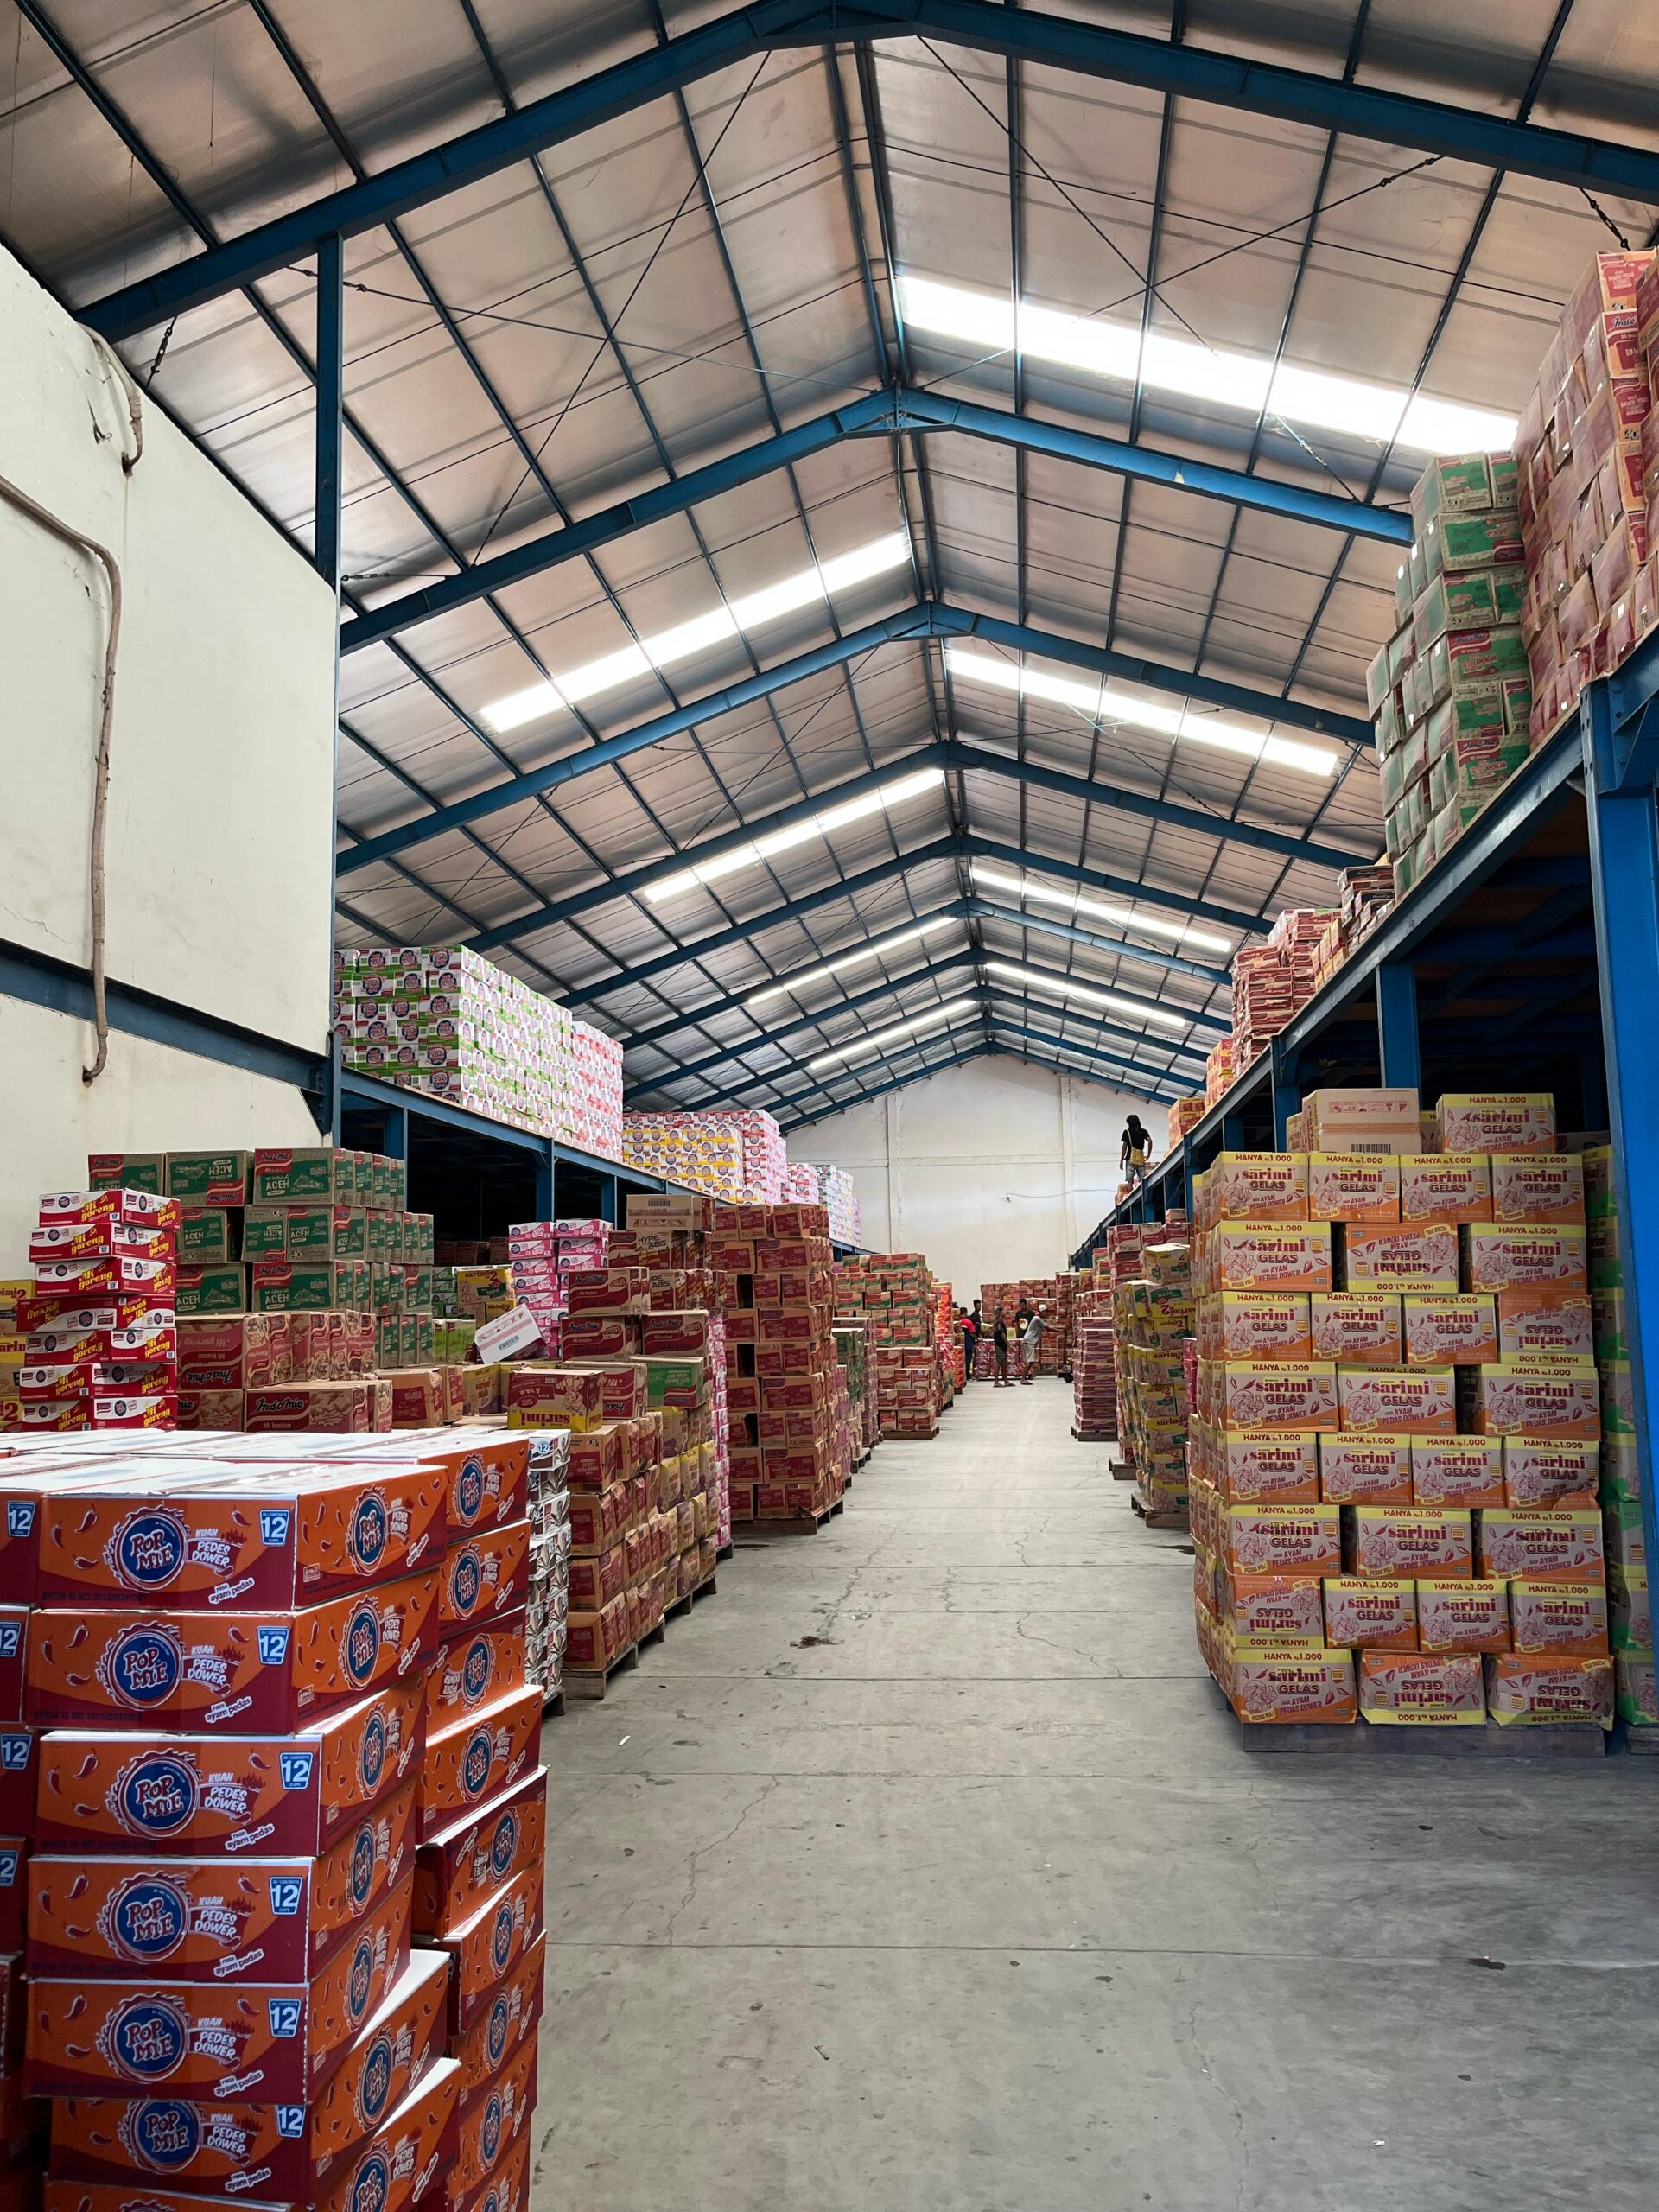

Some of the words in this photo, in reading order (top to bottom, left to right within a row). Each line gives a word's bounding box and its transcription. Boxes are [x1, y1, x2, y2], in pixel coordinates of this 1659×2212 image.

[1613, 316, 1636, 327] Indo
[1482, 1125, 1522, 1134] GELAS
[1242, 1168, 1293, 1180] sarimi
[1332, 1170, 1382, 1183] sarimi
[1421, 1170, 1473, 1182] sarimi
[266, 1179, 289, 1191] ACEH
[1249, 1181, 1286, 1192] GELAS
[1339, 1183, 1376, 1192] GELAS
[1429, 1183, 1466, 1193] GELAS
[81, 1202, 115, 1221] goreng
[185, 1231, 204, 1241] ACEH
[72, 1235, 104, 1254] goreng
[1503, 1242, 1561, 1255] sarimi
[1257, 1254, 1298, 1263] GELAS
[1512, 1257, 1554, 1267] GELAS
[79, 1271, 113, 1290] goreng
[265, 1294, 289, 1305] ACEH
[1243, 1308, 1294, 1321] sarimi
[1251, 1322, 1287, 1331] GELAS
[145, 1341, 170, 1358] goreng
[1255, 1379, 1313, 1392] sarimi
[1516, 1382, 1575, 1397] sarimi
[256, 1398, 305, 1412] Indomie
[1264, 1393, 1306, 1404] GELAS
[1525, 1398, 1567, 1410] GELAS
[144, 1408, 170, 1427] goreng
[521, 1412, 570, 1425] sarimi
[1249, 1448, 1302, 1461] sarimi
[1531, 1455, 1586, 1469] sarimi
[1258, 1462, 1296, 1472] GELAS
[1540, 1469, 1578, 1480] GELAS
[9, 1510, 30, 1529] 12
[195, 1529, 218, 1537] KUAH
[262, 1517, 286, 1538] 12
[131, 1529, 163, 1556] POP
[197, 1541, 231, 1555] PEDES
[1270, 1537, 1312, 1548] GELAS
[137, 1544, 173, 1571] MIE
[192, 1551, 230, 1567] DOWER
[209, 1589, 232, 1603] ayam
[232, 1579, 253, 1596] pedas
[191, 1645, 214, 1655] KUAH
[260, 1636, 285, 1656] 12
[124, 1648, 158, 1674] POP
[193, 1659, 227, 1673] PEDES
[130, 1662, 168, 1690] MIE
[188, 1669, 226, 1685] DOWER
[1268, 1668, 1326, 1682] sarimi
[1278, 1685, 1319, 1694] GELAS
[206, 1707, 228, 1722] ayam
[227, 1697, 251, 1715] pedas
[208, 1773, 233, 1783] KUAH
[283, 1760, 310, 1782] 12
[136, 1775, 172, 1804] POP
[210, 1787, 246, 1800] PEDES
[143, 1790, 184, 1818] MIE
[205, 1797, 246, 1813] DOWER
[226, 1835, 249, 1850] ayam
[249, 1825, 274, 1843] pedas
[198, 1897, 223, 1906] KUAH
[273, 1885, 298, 1907] 12
[127, 1898, 164, 1927] POP
[200, 1910, 238, 1923] PEDES
[133, 1914, 173, 1942] MIE
[194, 1921, 237, 1937] DOWER
[215, 1961, 238, 1976] ayam
[238, 1949, 263, 1969] pedas
[197, 2018, 222, 2027] KUAH
[271, 2006, 297, 2030] 12
[124, 2019, 162, 2047] POP
[200, 2031, 236, 2047] PEDES
[132, 2035, 172, 2063] MIE
[194, 2043, 236, 2058] DOWER
[215, 2081, 238, 2096] ayam
[238, 2071, 263, 2089] pedas
[145, 2111, 179, 2137] POP
[211, 2113, 233, 2123] KUAH
[278, 2108, 302, 2130] 12
[152, 2126, 188, 2153] MIE
[212, 2126, 246, 2143] PEDES
[207, 2137, 246, 2155] DOWER
[226, 2177, 250, 2192] ayam
[248, 2168, 270, 2186] pedas
